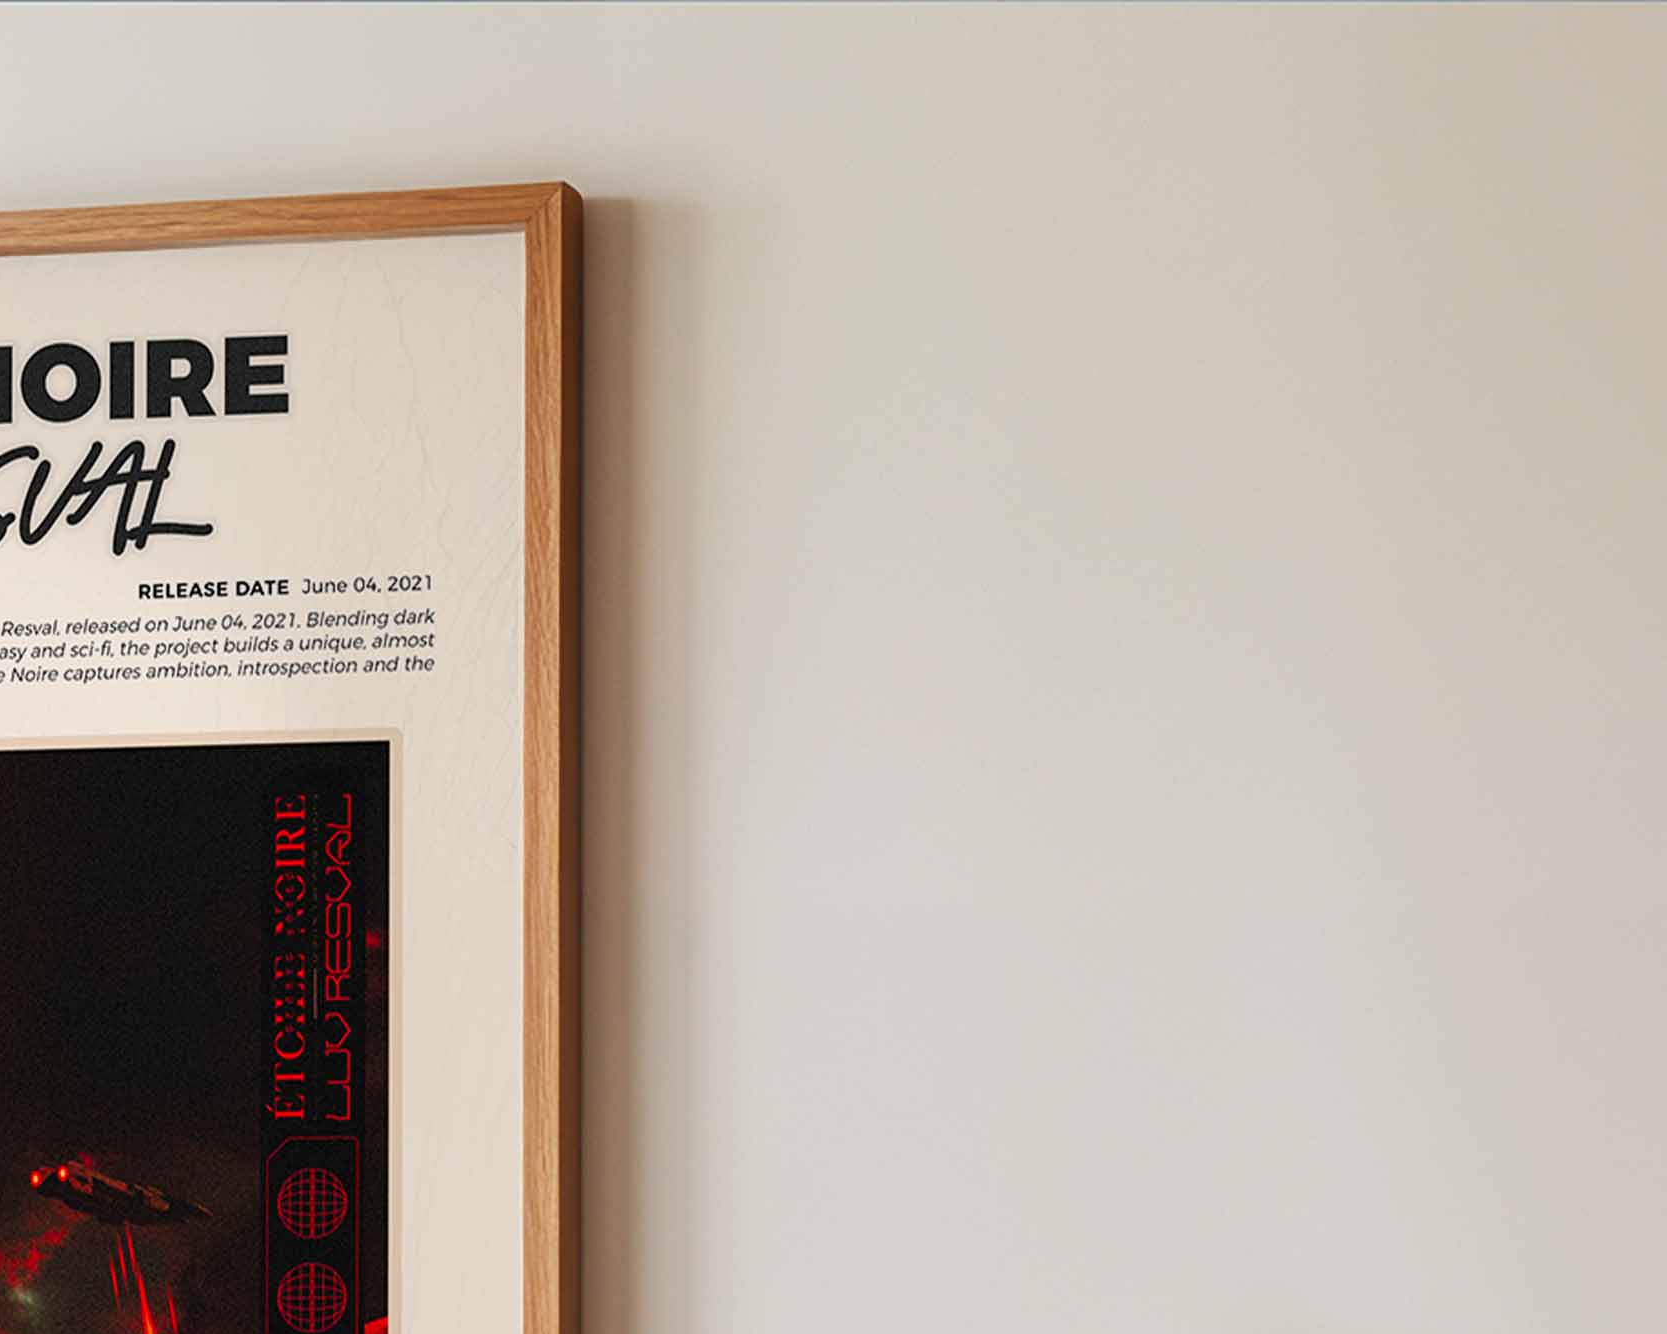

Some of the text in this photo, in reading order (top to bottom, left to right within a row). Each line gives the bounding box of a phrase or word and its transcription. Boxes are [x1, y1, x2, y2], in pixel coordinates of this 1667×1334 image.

[139, 581, 228, 600] RELEASE
[236, 579, 289, 596] DATE
[302, 579, 347, 594] June
[388, 575, 431, 592] 2021
[66, 617, 141, 634] released
[145, 620, 168, 633] on
[173, 616, 217, 632] June
[252, 612, 300, 630] 2021.
[307, 610, 389, 629] Blending
[394, 608, 435, 625] dark
[31, 642, 66, 659] and
[121, 640, 150, 656] the
[154, 638, 218, 658] project
[224, 636, 278, 653] builds
[283, 639, 293, 652] a
[299, 634, 366, 653] unique,
[372, 633, 435, 649] almost
[11, 666, 58, 682] Noire
[64, 666, 141, 684] captures
[146, 661, 231, 679] ambition,
[238, 658, 357, 678] introspection
[363, 656, 399, 673] and
[405, 656, 434, 672] the
[273, 793, 306, 936] NOIRE
[324, 793, 352, 1121] LUV RESVAL
